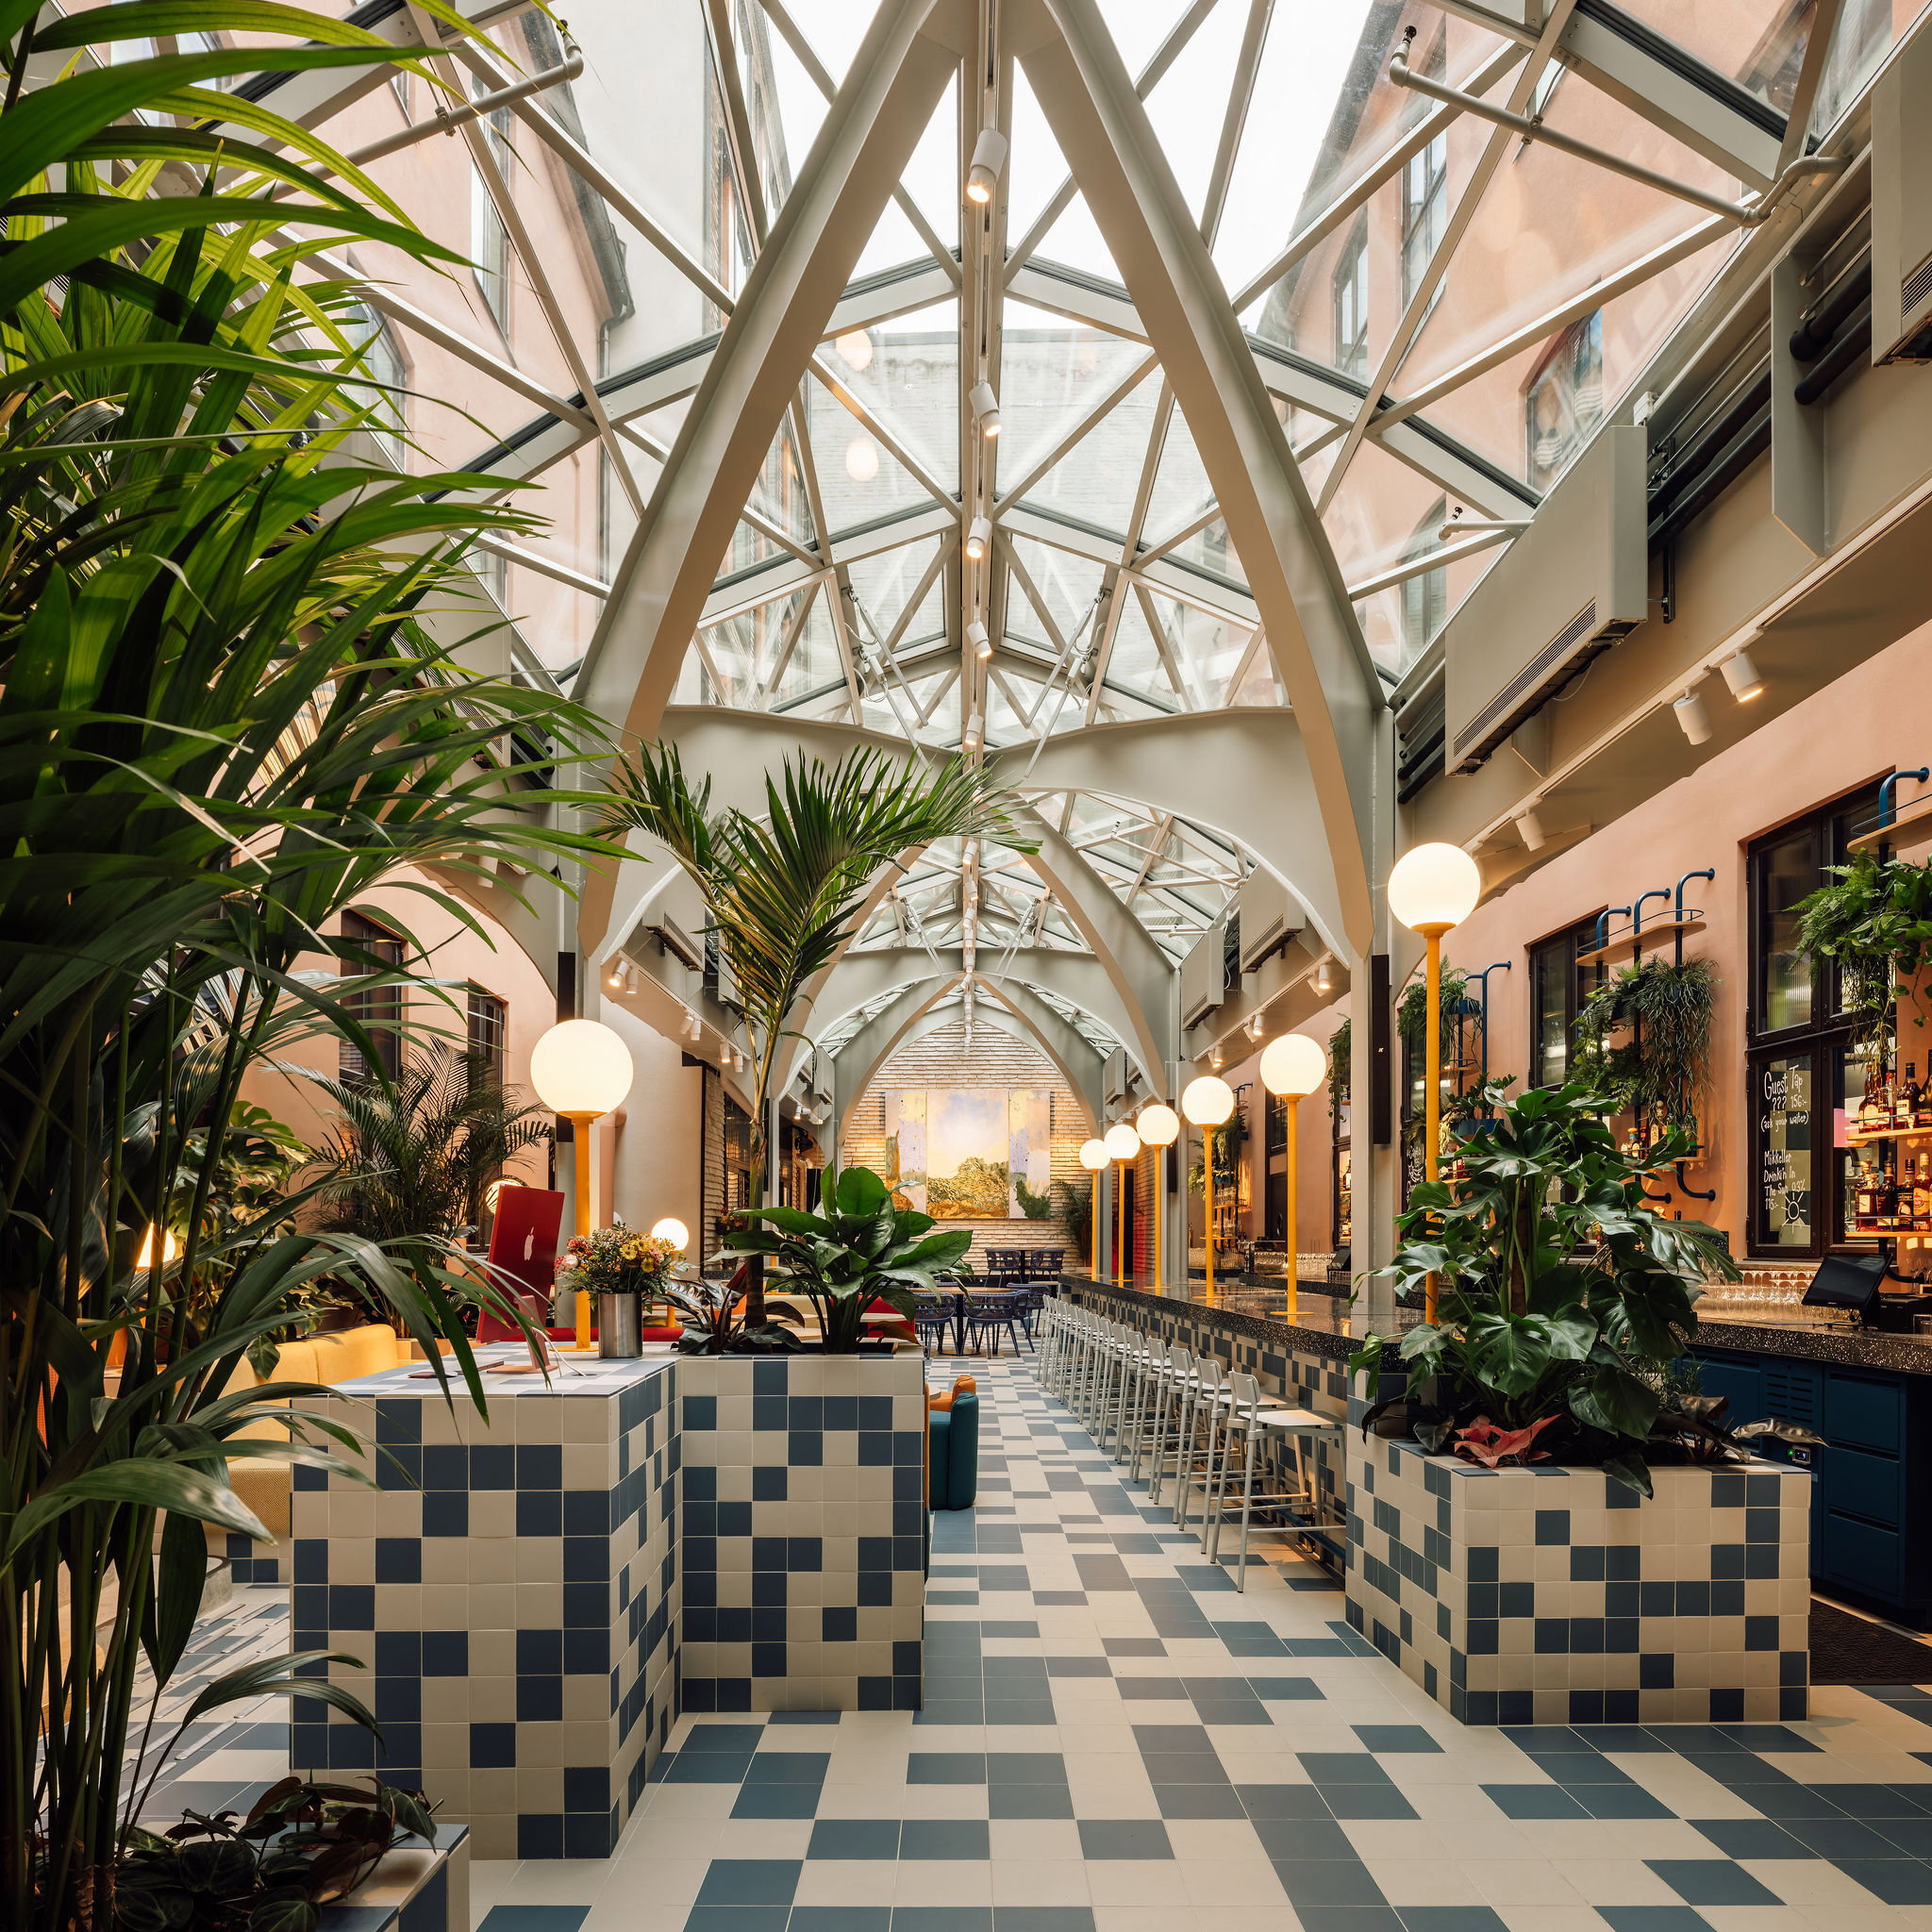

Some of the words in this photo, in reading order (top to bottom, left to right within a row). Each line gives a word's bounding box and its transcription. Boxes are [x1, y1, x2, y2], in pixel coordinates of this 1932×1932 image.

[1764, 1071, 1789, 1100] Guest
[1789, 1064, 1803, 1093] Tap
[1774, 1118, 1788, 1133] your
[1764, 1148, 1792, 1167] Mikkeller
[1764, 1184, 1776, 1197] The
